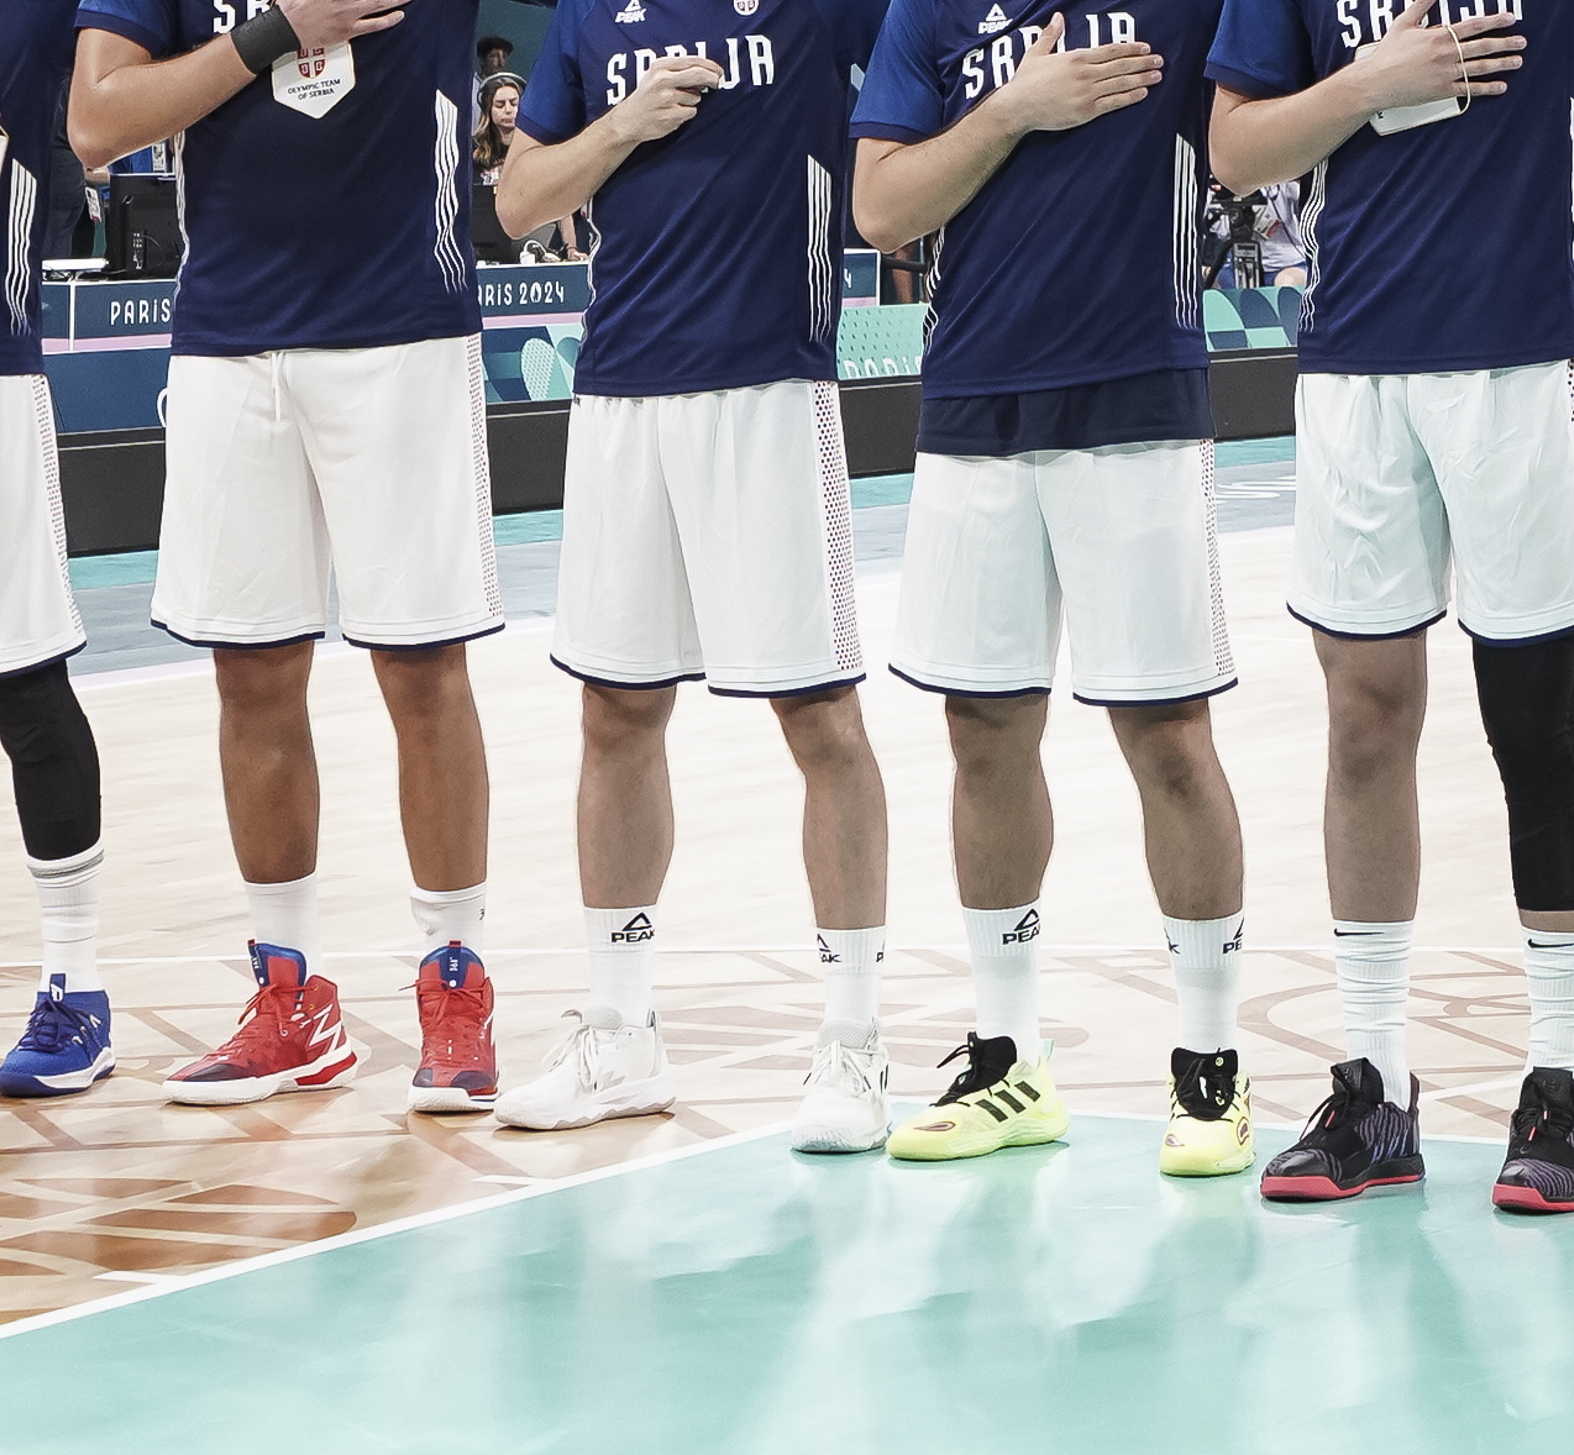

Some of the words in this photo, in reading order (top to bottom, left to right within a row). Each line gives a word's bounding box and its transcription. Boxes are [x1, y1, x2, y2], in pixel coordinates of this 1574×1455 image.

[287, 81, 320, 95] OLYMPIC
[321, 78, 341, 89] TEAM
[297, 92, 307, 101] OF
[307, 88, 334, 100] SERBIA
[478, 283, 513, 307] RIS
[518, 281, 565, 305] 2024
[110, 298, 172, 326] PARIS
[611, 929, 655, 944] PEAK
[1002, 927, 1040, 945] PEA
